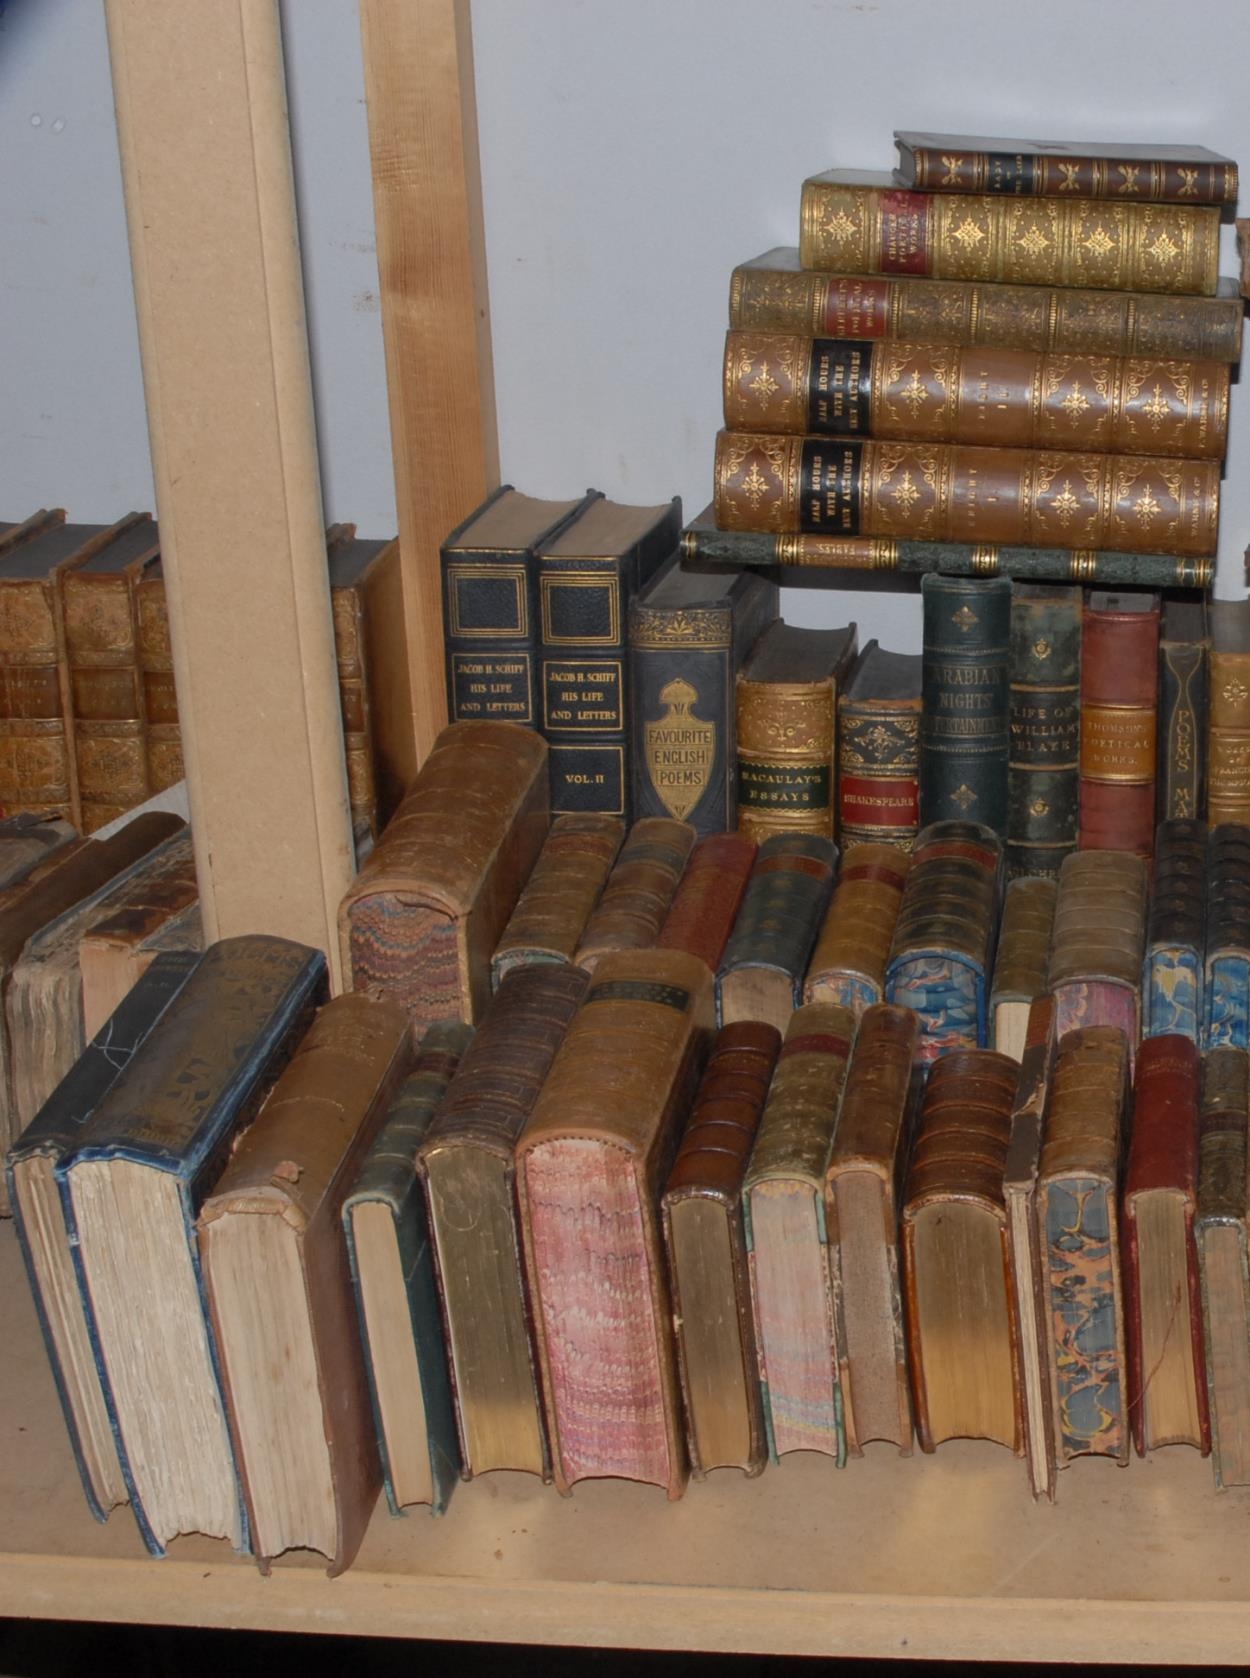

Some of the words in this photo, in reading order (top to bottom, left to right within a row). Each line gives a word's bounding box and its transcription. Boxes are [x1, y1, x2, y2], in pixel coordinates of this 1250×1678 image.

[819, 355, 830, 391] HOURS
[834, 365, 844, 385] THE
[849, 351, 861, 402] AUTHORS
[834, 392, 844, 417] WITH
[812, 455, 822, 491] HOURS
[827, 464, 837, 485] THE
[842, 451, 853, 501] AUTHORS
[811, 499, 821, 523] HALF
[827, 491, 837, 517] WITH
[457, 664, 484, 674] JACOB
[495, 663, 525, 674] SCHIFF
[549, 672, 575, 682] JACOB
[586, 671, 617, 682] SCHIFF
[470, 683, 487, 694] HIS
[491, 683, 512, 694] LIFE
[561, 691, 578, 702] HIS
[582, 691, 604, 702] LIFE
[939, 693, 994, 709] NIGHTS
[460, 702, 480, 712] AND
[486, 701, 526, 712] LETTERS
[1014, 707, 1048, 719] LIFE
[1054, 706, 1074, 718] OF
[551, 710, 571, 720] AND
[577, 710, 617, 721] LETTERS
[649, 729, 711, 745] FAVOURITE
[1009, 724, 1077, 736] WILLIAM
[1175, 710, 1192, 772] POEMS
[654, 750, 705, 765] ENGLISH
[565, 775, 594, 784] VOL.
[595, 775, 605, 784] II
[659, 771, 701, 785] POEMS
[742, 771, 823, 784] MACAULAY'S
[749, 790, 811, 802] ESSAYS
